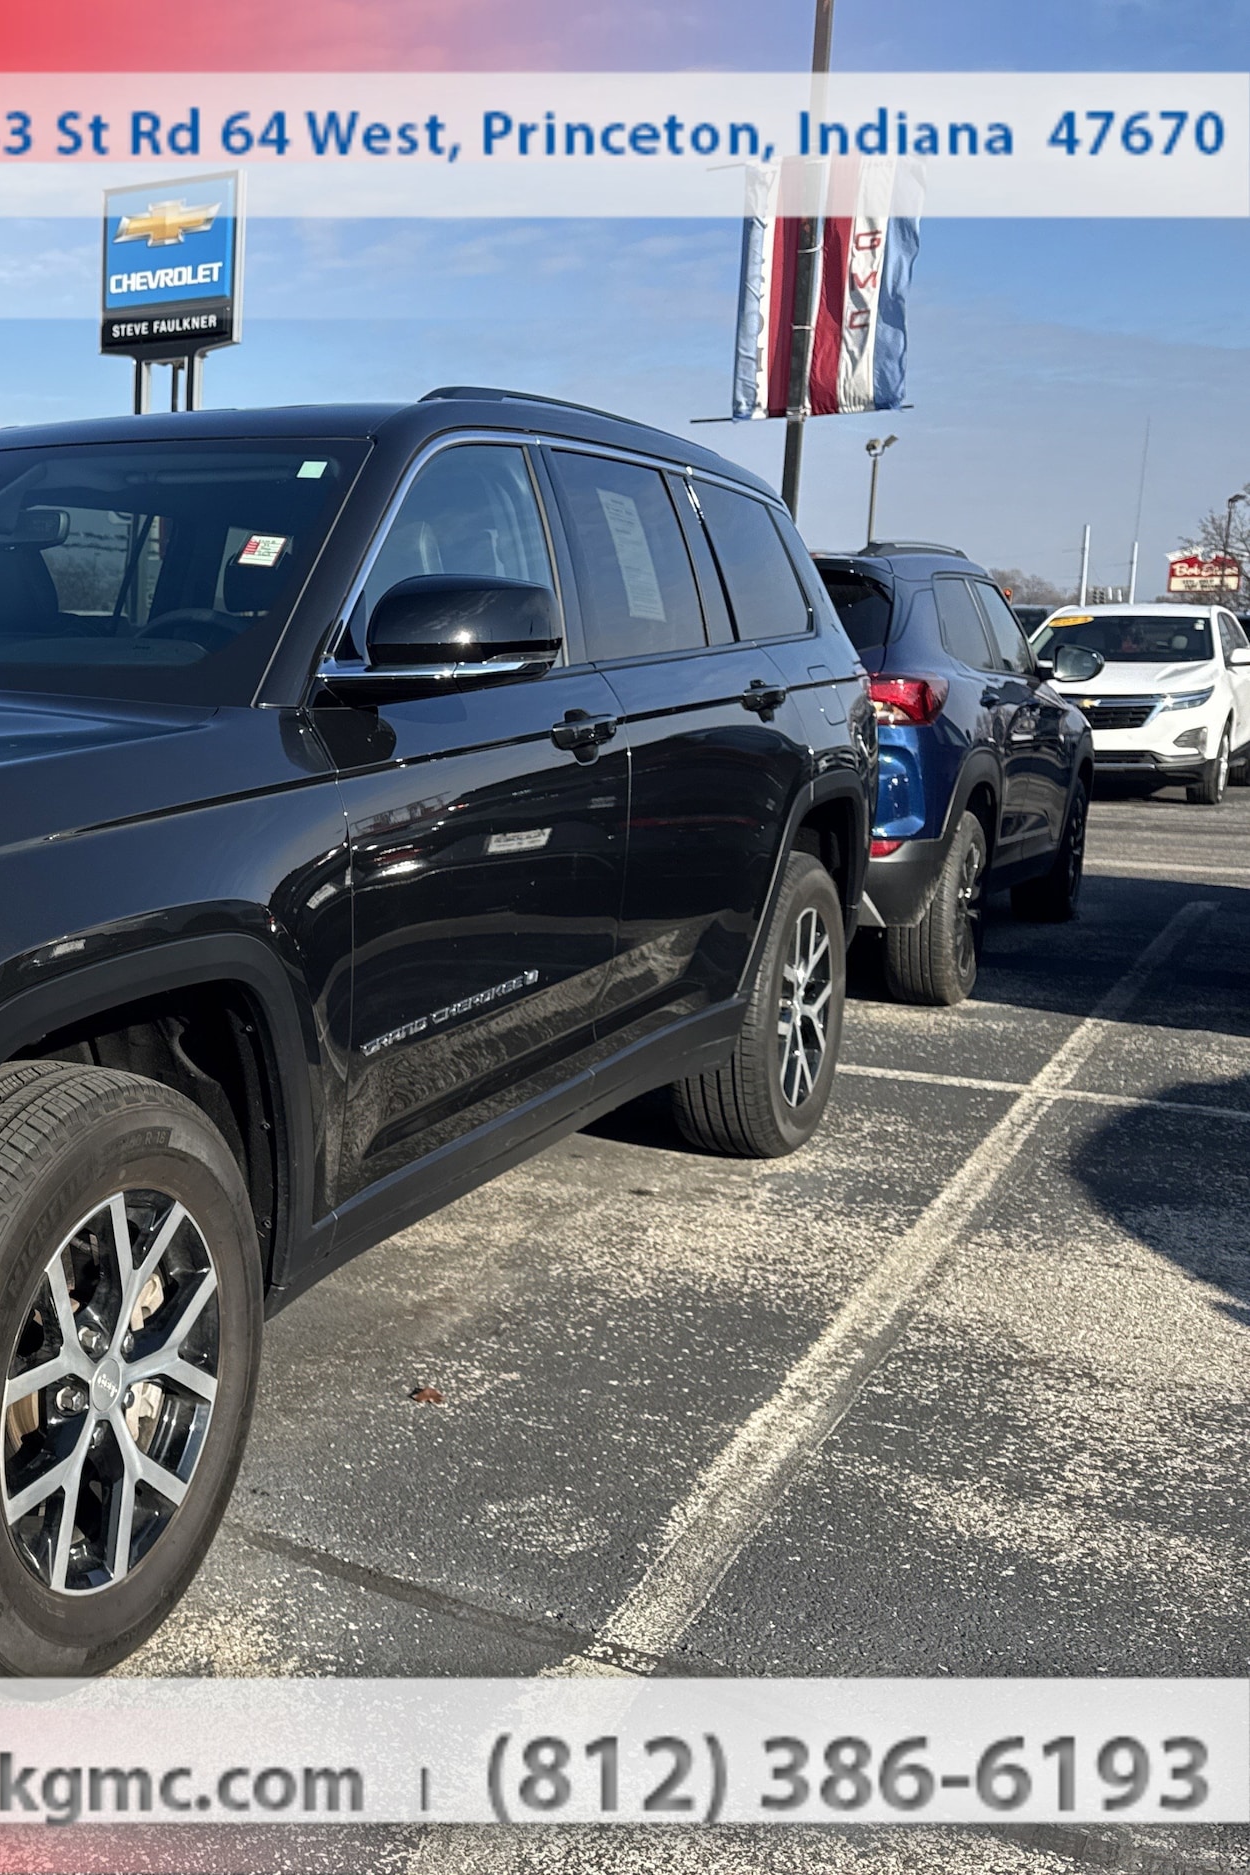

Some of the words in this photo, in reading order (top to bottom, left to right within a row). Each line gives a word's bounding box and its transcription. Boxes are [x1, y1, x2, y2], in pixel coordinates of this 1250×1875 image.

[109, 261, 222, 294] CHEVROLET
[112, 322, 149, 338] STEVE
[152, 314, 217, 334] FAULKNER
[359, 1016, 428, 1057] GRAND
[430, 974, 525, 1025] CHEROKEE
